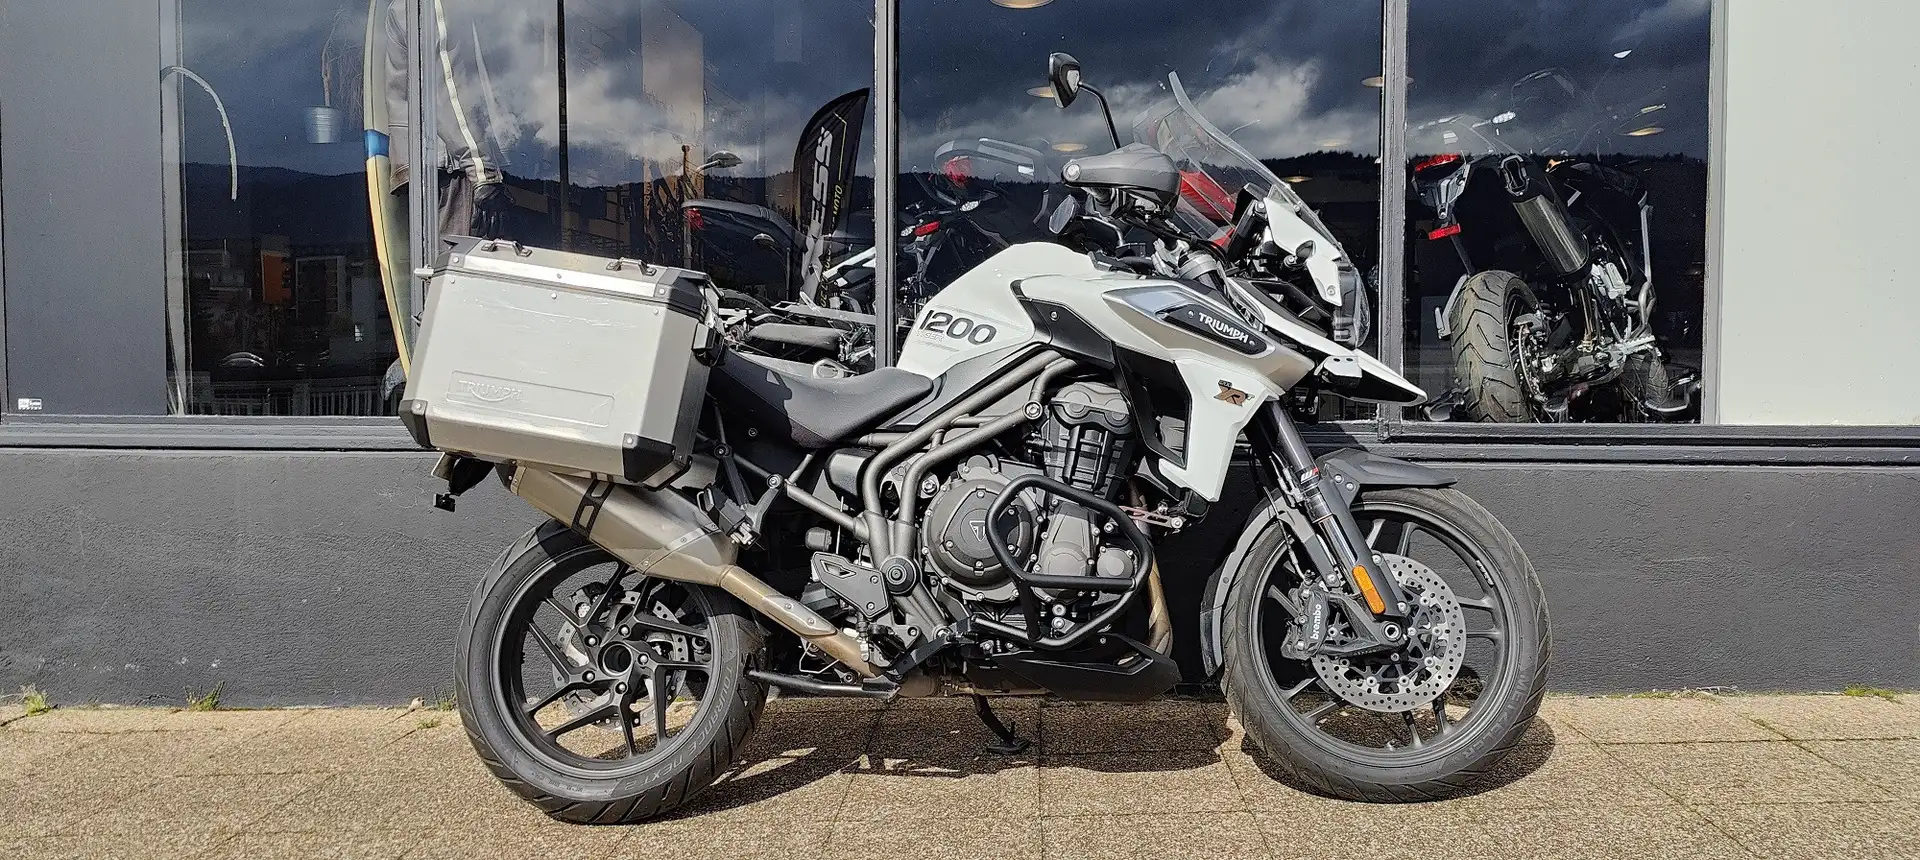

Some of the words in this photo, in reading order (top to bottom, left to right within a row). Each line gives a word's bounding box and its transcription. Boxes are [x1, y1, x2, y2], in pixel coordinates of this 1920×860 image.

[919, 309, 997, 346] 1200
[1199, 312, 1249, 344] TRIUMPH
[458, 379, 522, 402] TRIUMPH
[1310, 603, 1322, 640] brembo
[688, 665, 734, 756] TOURANCE
[1462, 672, 1530, 760] METZELER
[641, 756, 683, 788] NEXT
